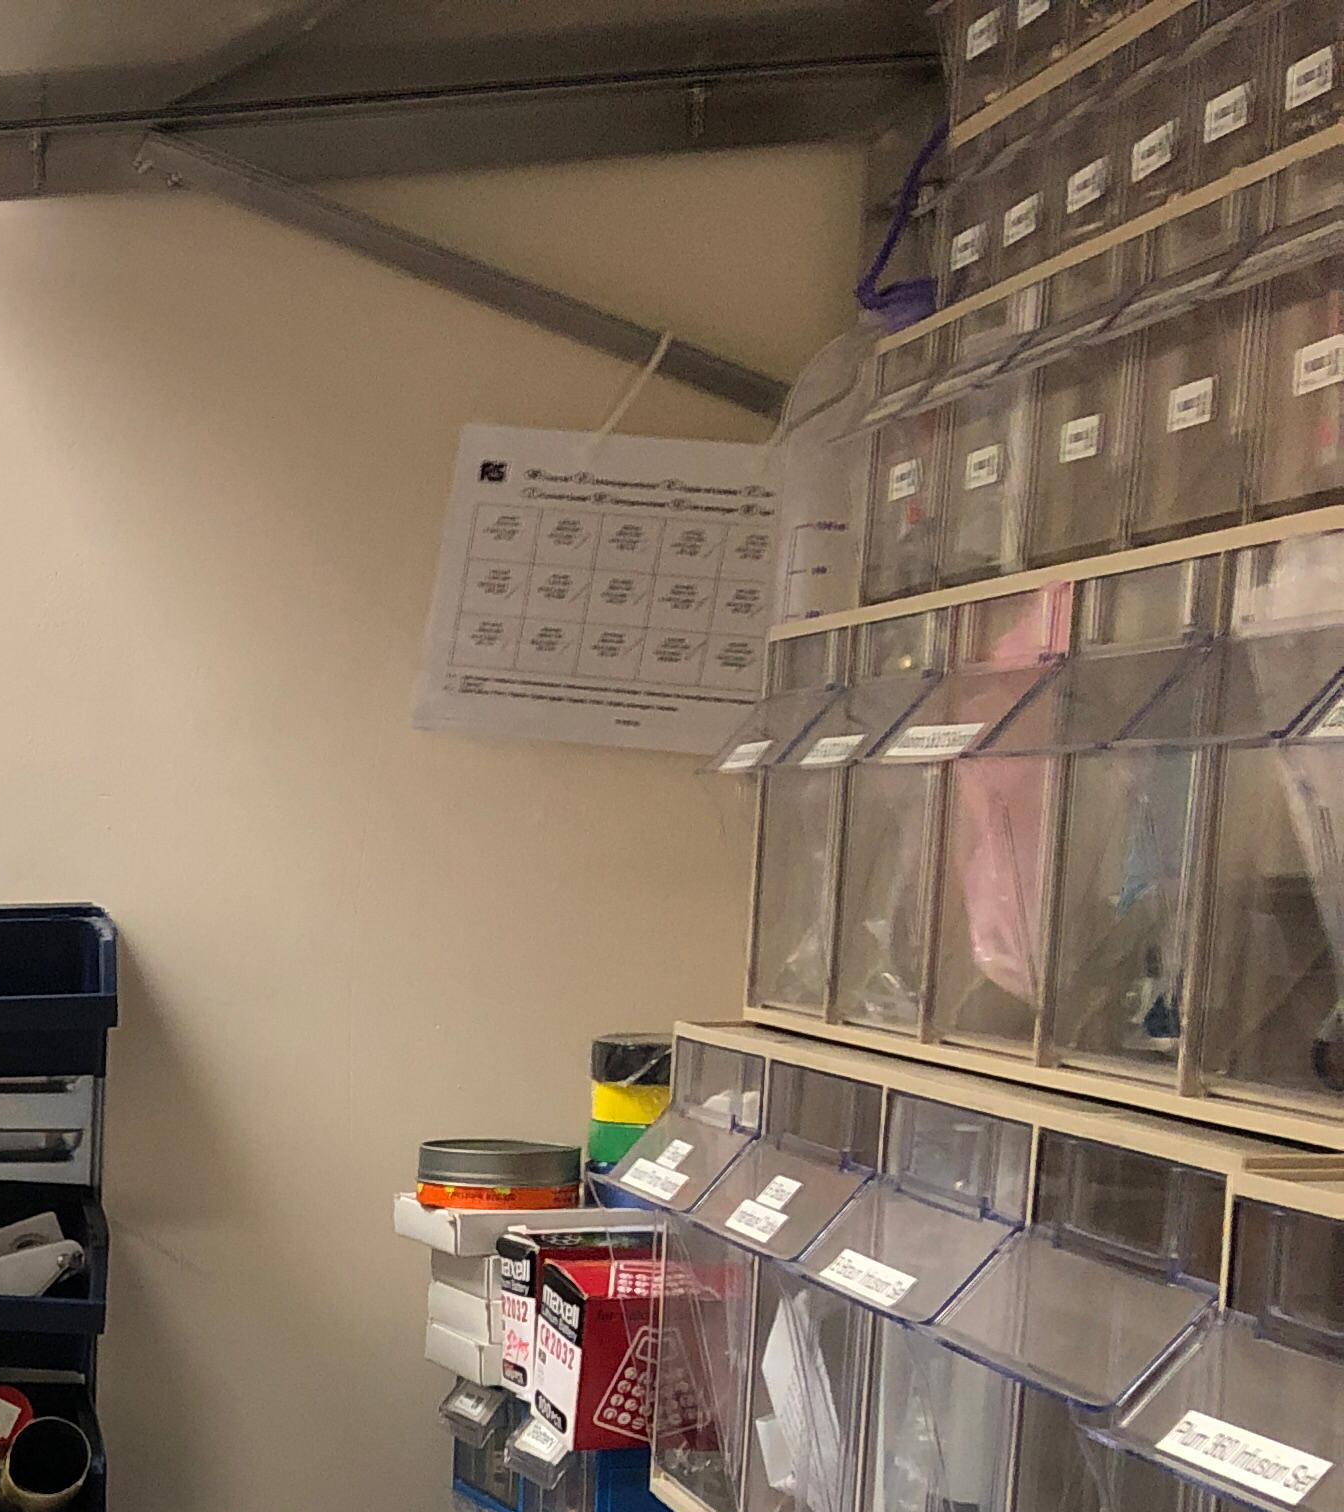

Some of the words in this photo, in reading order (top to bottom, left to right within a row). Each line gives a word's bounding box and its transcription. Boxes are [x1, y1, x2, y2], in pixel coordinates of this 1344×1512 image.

[501, 1257, 531, 1283] axell
[501, 1294, 529, 1324] R2032
[542, 1284, 580, 1331] maxell
[539, 1323, 576, 1371] CR2032
